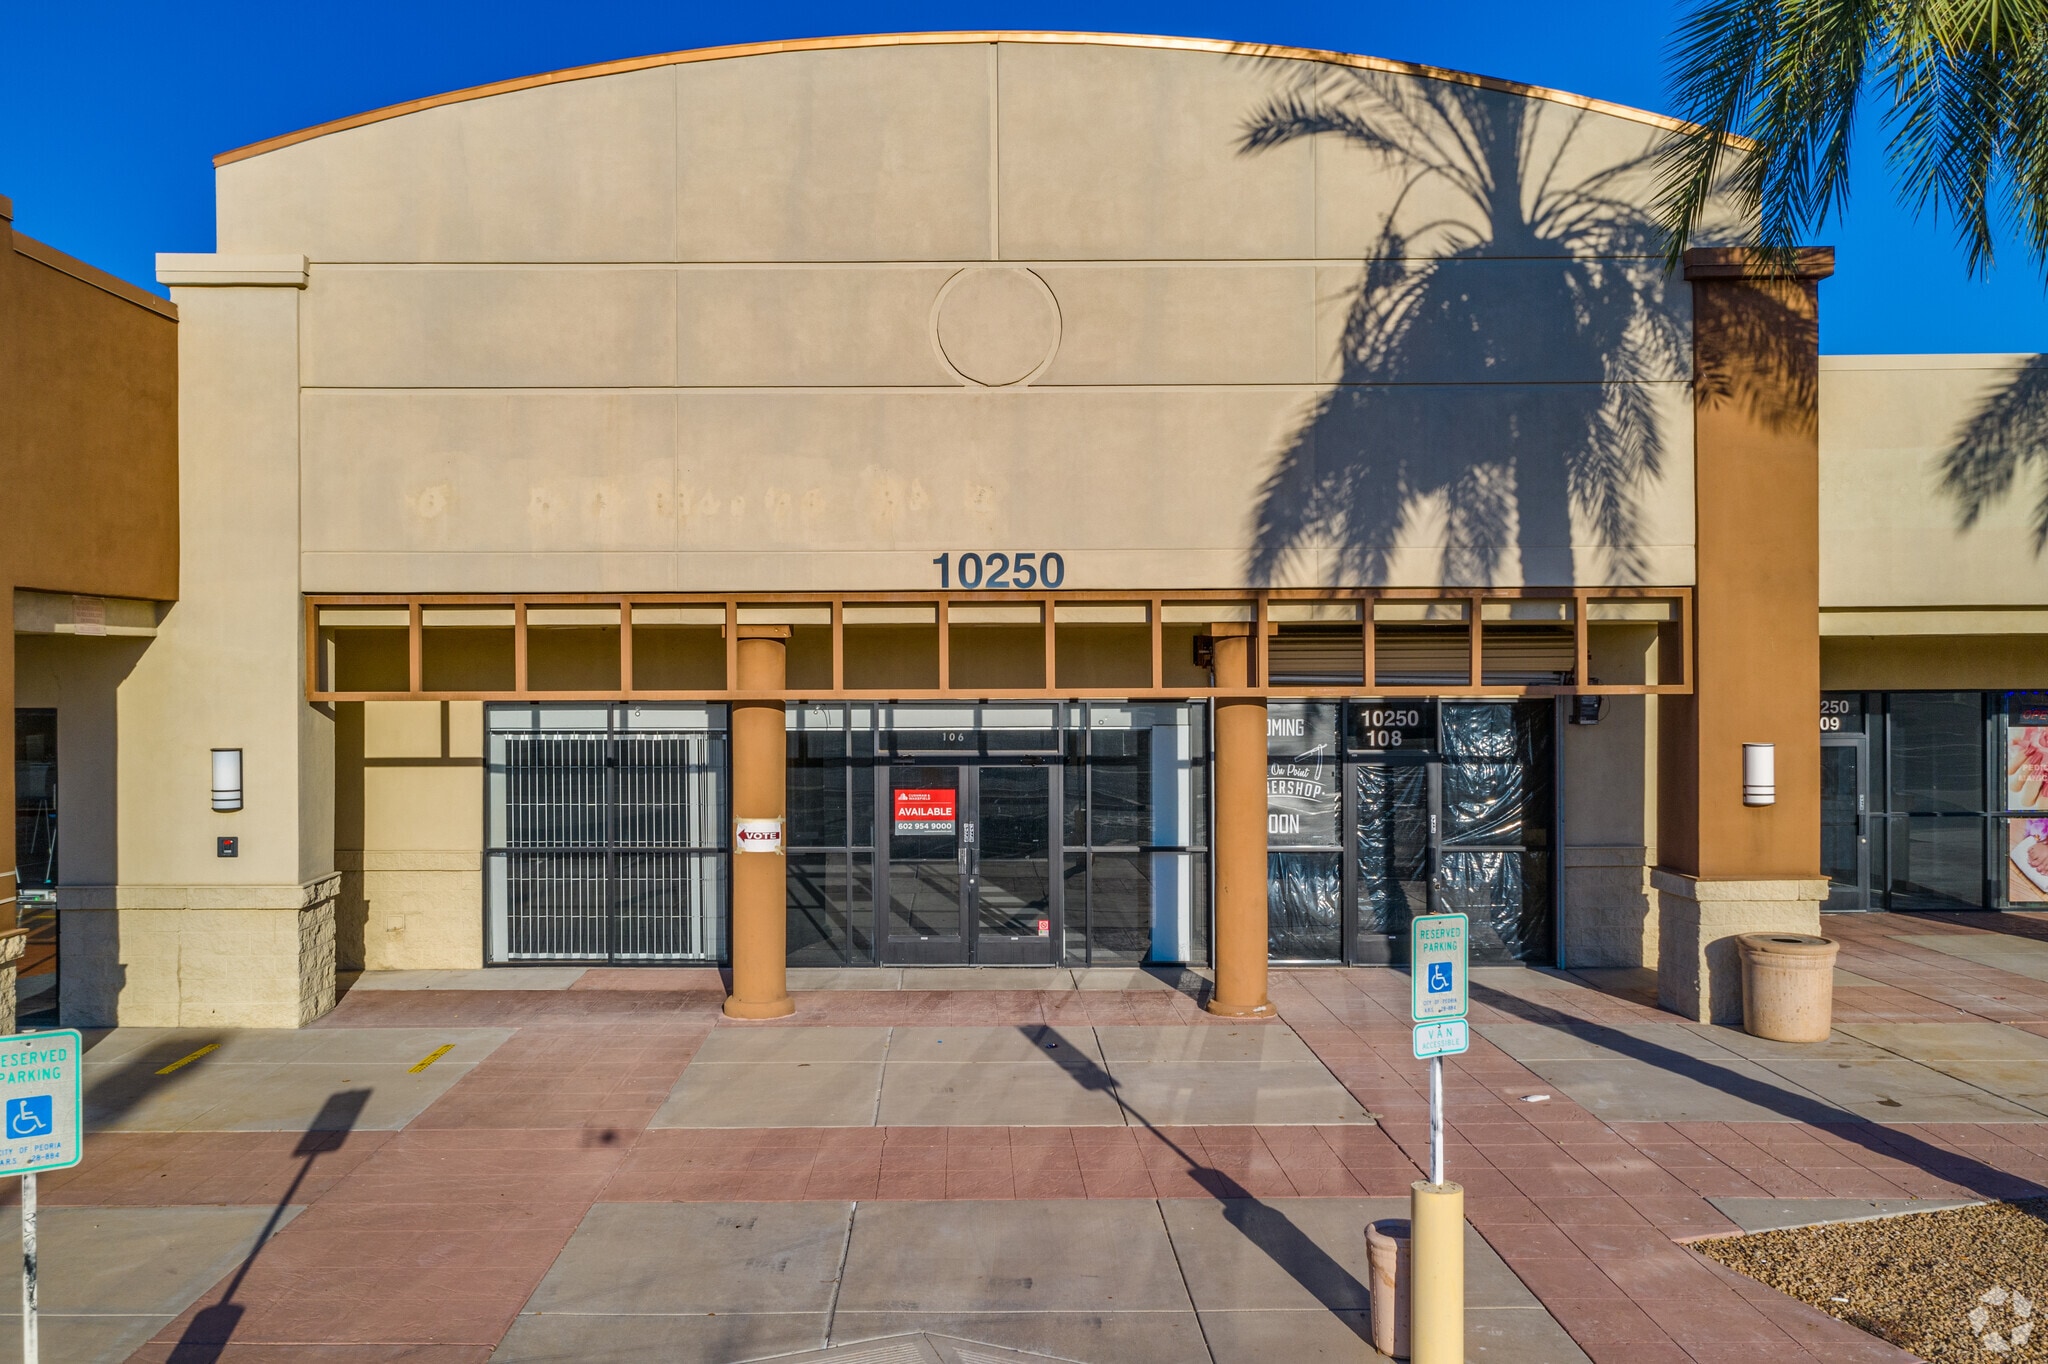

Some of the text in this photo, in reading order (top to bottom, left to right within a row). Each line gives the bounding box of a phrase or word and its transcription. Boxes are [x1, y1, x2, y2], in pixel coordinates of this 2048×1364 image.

[933, 552, 1065, 589] 10250
[1820, 700, 1849, 713] 250
[1361, 710, 1419, 727] 10250
[1820, 717, 1840, 730] 09
[942, 732, 964, 742] 106
[1366, 730, 1402, 747] 108
[1287, 764, 1311, 778] Point
[1267, 780, 1322, 799] ERSHOP
[898, 807, 953, 816] AVAILABLE
[898, 822, 952, 830] 602 954 9000
[746, 832, 777, 840] VOTE
[1420, 927, 1461, 940] RESERVED
[1423, 941, 1458, 953] PARKING
[1428, 1028, 1453, 1039] VAN
[1422, 1038, 1460, 1050] ACCESSIBLE
[19, 1146, 28, 1154] OF
[34, 1142, 61, 1151] PEORIA
